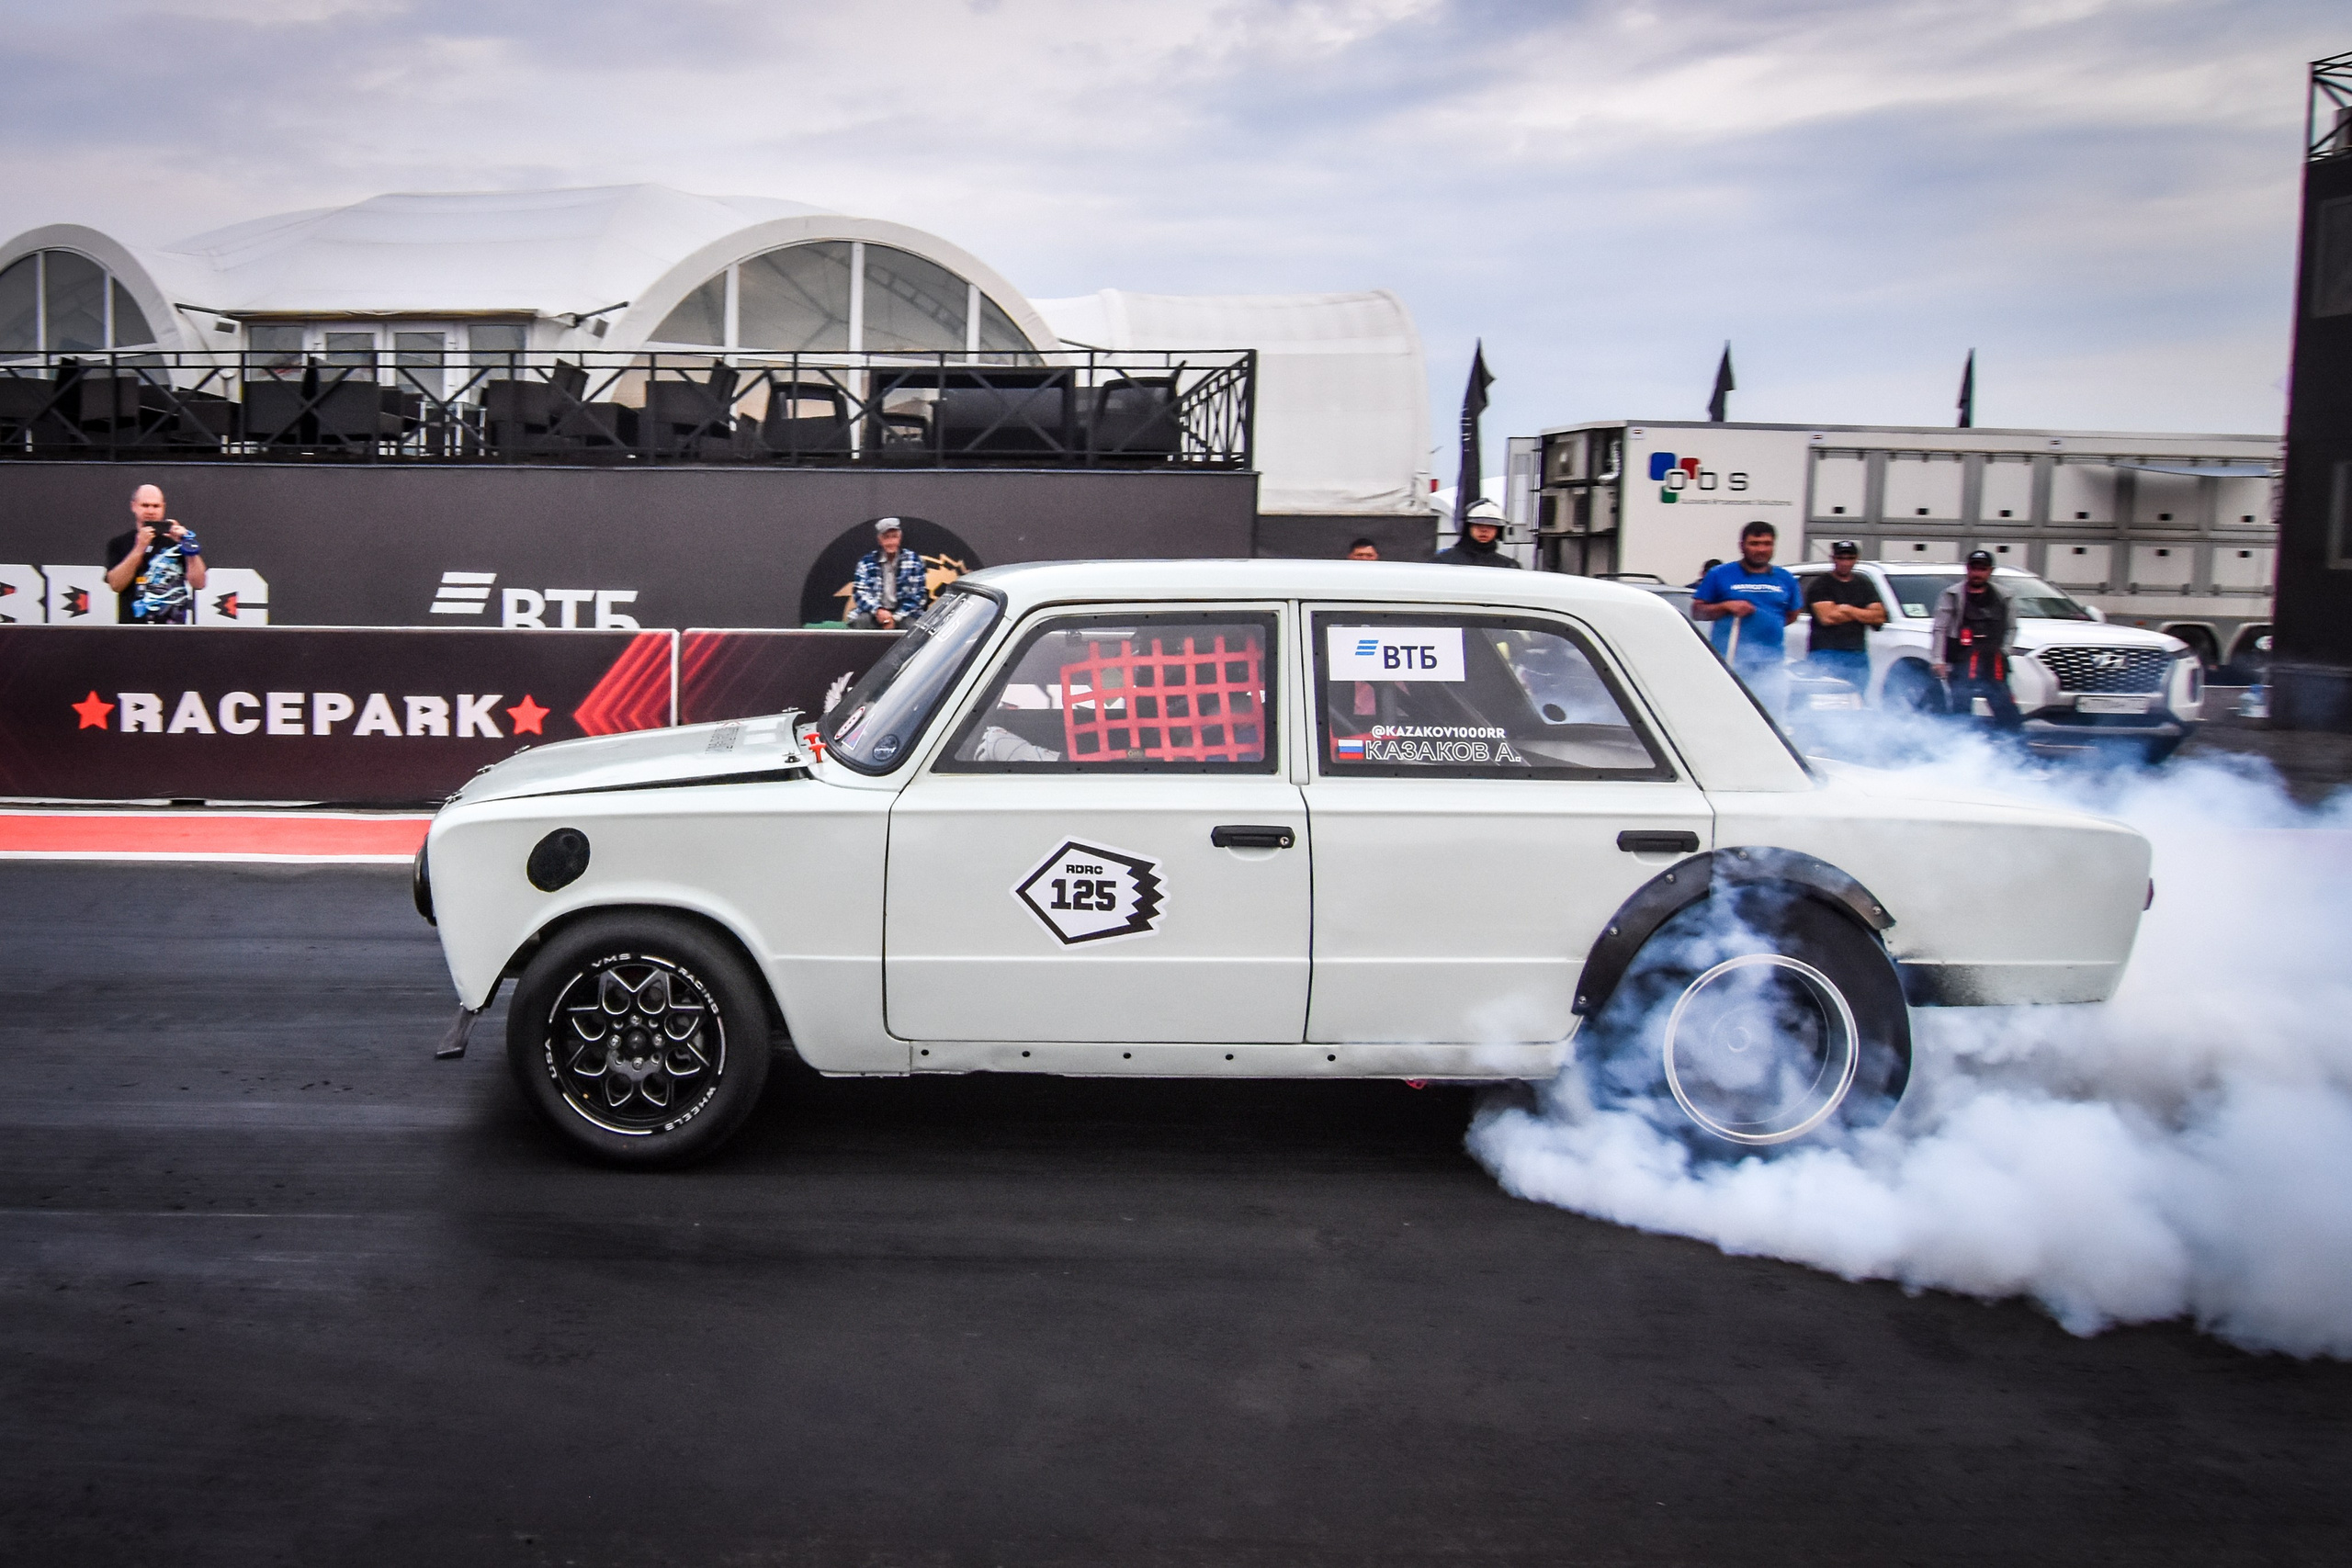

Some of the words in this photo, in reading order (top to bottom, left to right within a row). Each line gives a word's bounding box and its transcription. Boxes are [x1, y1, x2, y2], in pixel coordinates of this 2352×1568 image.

[1383, 645, 1438, 670] ВТБ
[118, 691, 504, 739] RACEPARK
[1371, 725, 1507, 739] @KAZAKOV1000RR
[1365, 739, 1490, 762] КАЗАКОВ
[1495, 741, 1521, 762] А.
[1066, 863, 1103, 875] RDRC
[1050, 878, 1117, 912] 125
[591, 953, 631, 968] VMS
[677, 966, 720, 1015] RACING
[544, 1037, 558, 1078] USA
[663, 1086, 718, 1132] WHEELS
